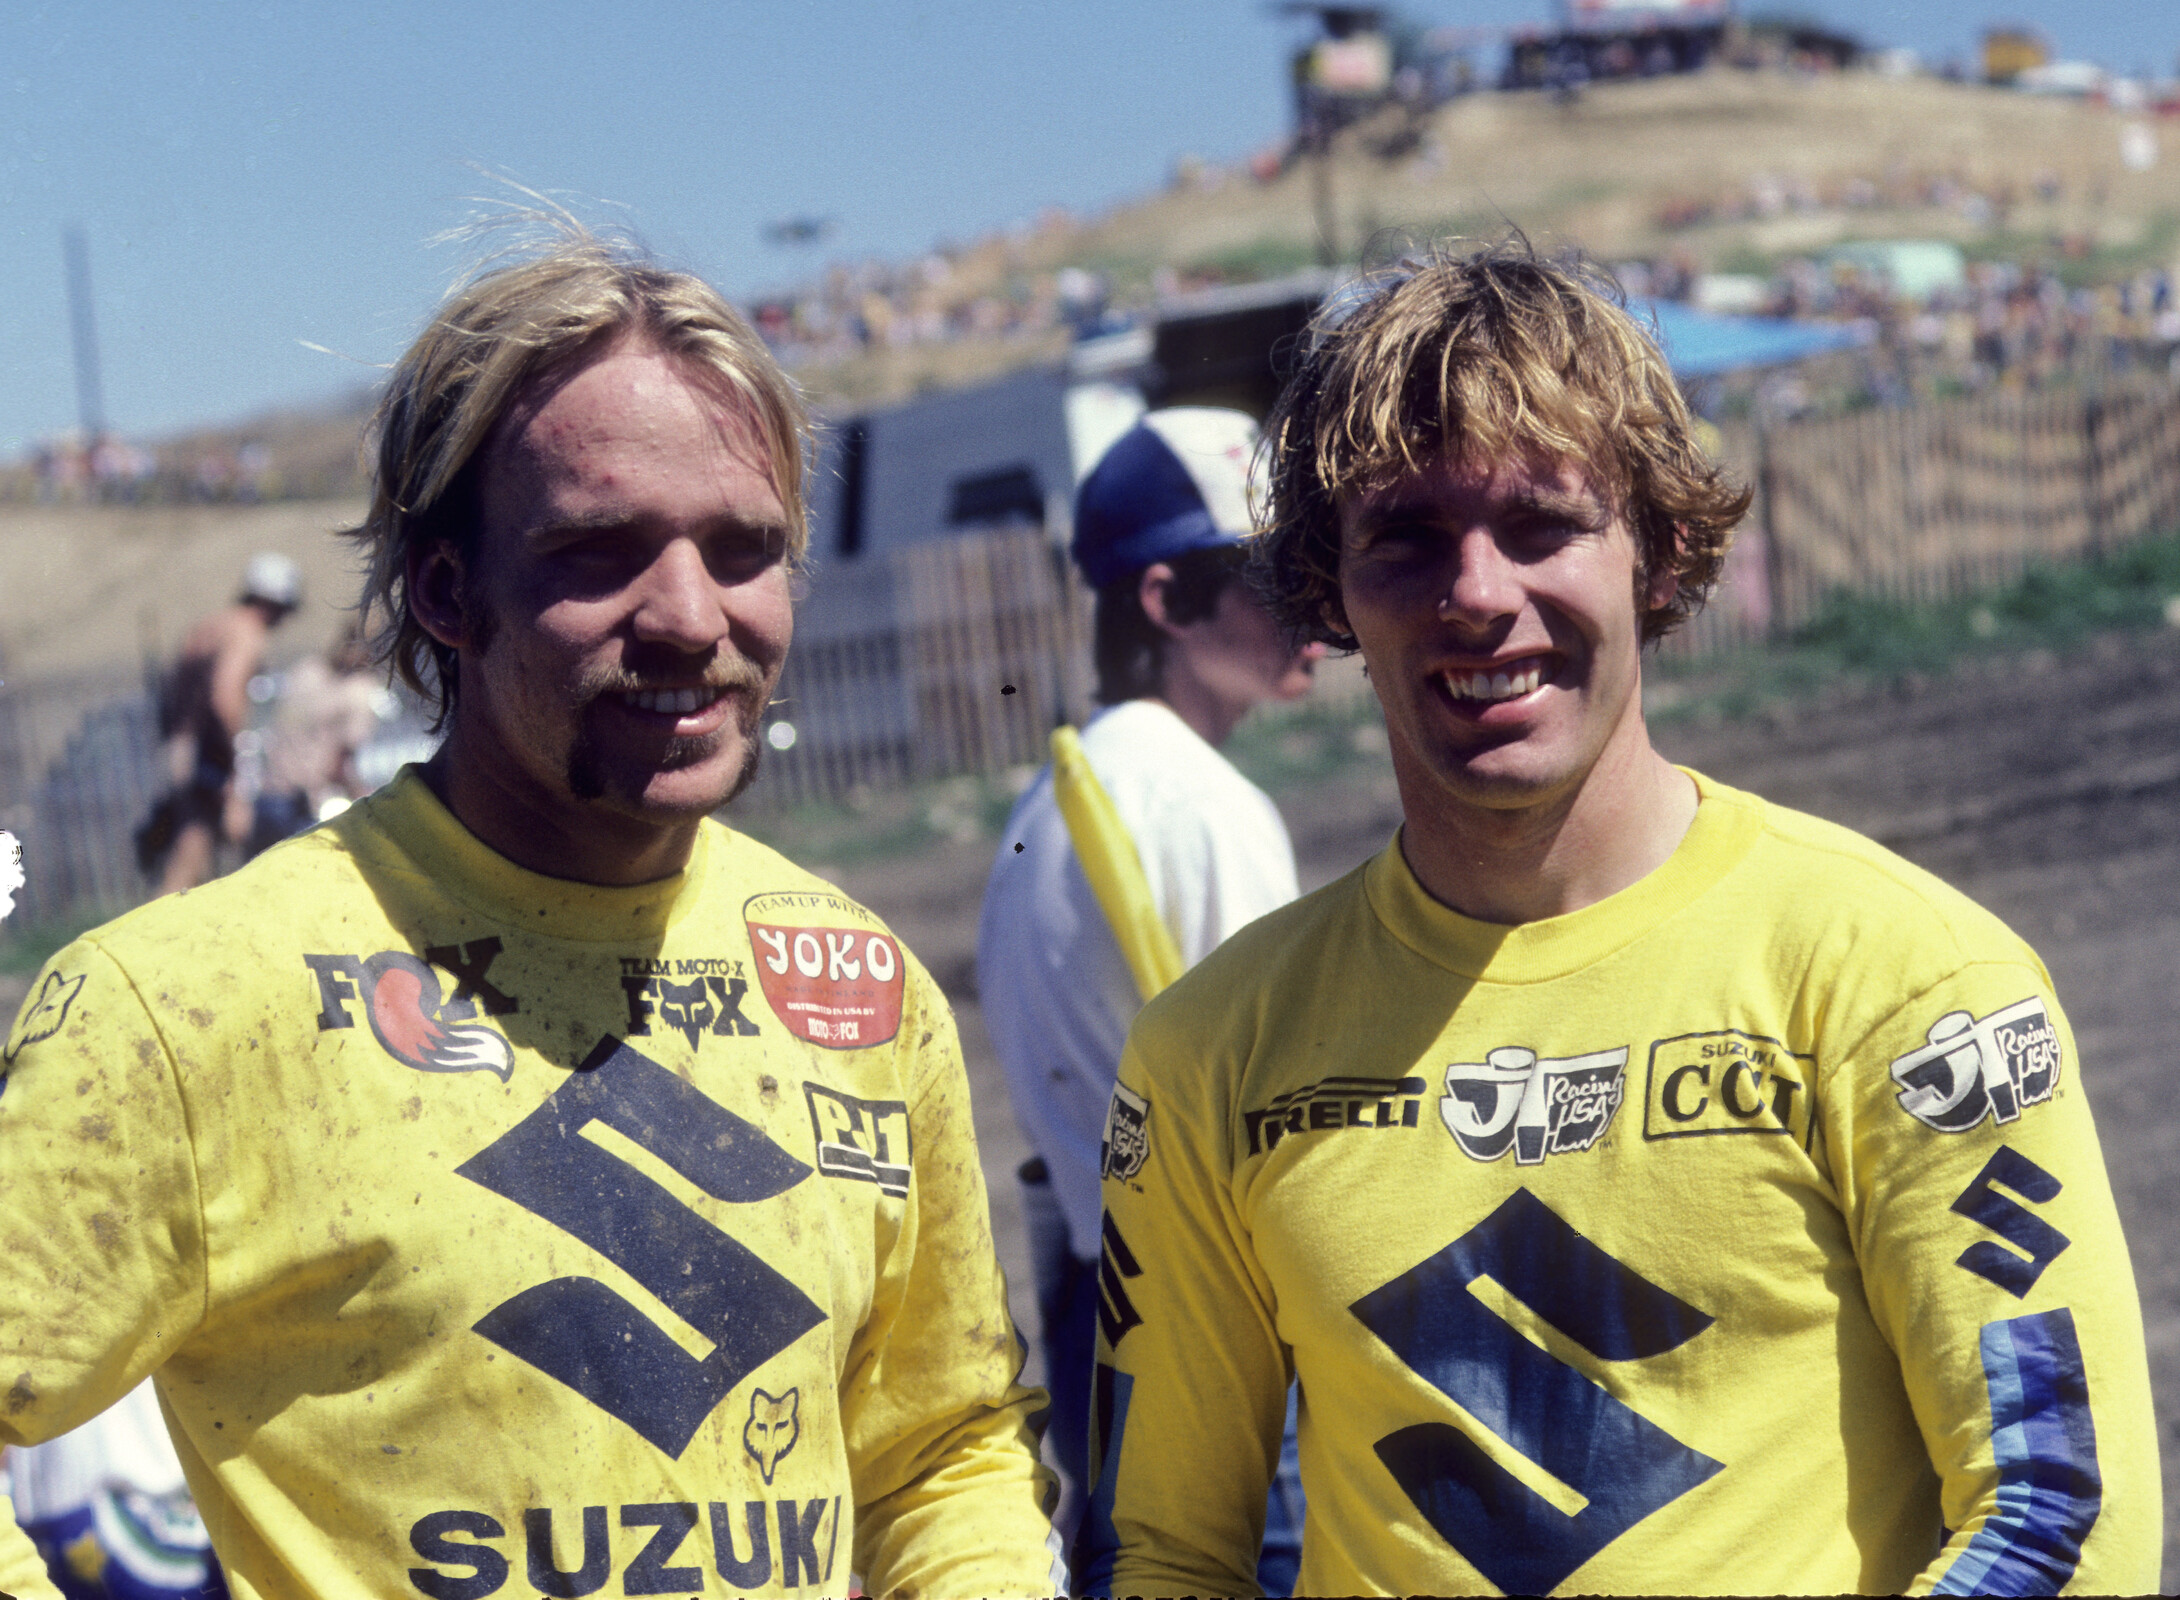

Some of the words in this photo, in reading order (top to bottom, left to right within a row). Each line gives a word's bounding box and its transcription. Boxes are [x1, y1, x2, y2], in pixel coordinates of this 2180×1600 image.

[752, 896, 795, 914] TEAM
[798, 897, 820, 908] UP
[620, 957, 672, 976] TEAM
[757, 927, 896, 983] YOKO
[302, 936, 519, 1084] FOX
[844, 1007, 862, 1016] USA
[863, 1007, 876, 1016] BY
[839, 1020, 860, 1041] FOX
[1701, 1041, 1777, 1068] SUZUKI
[1245, 1076, 1427, 1158] PIRELLI
[408, 1495, 842, 1600] SUZUKI
